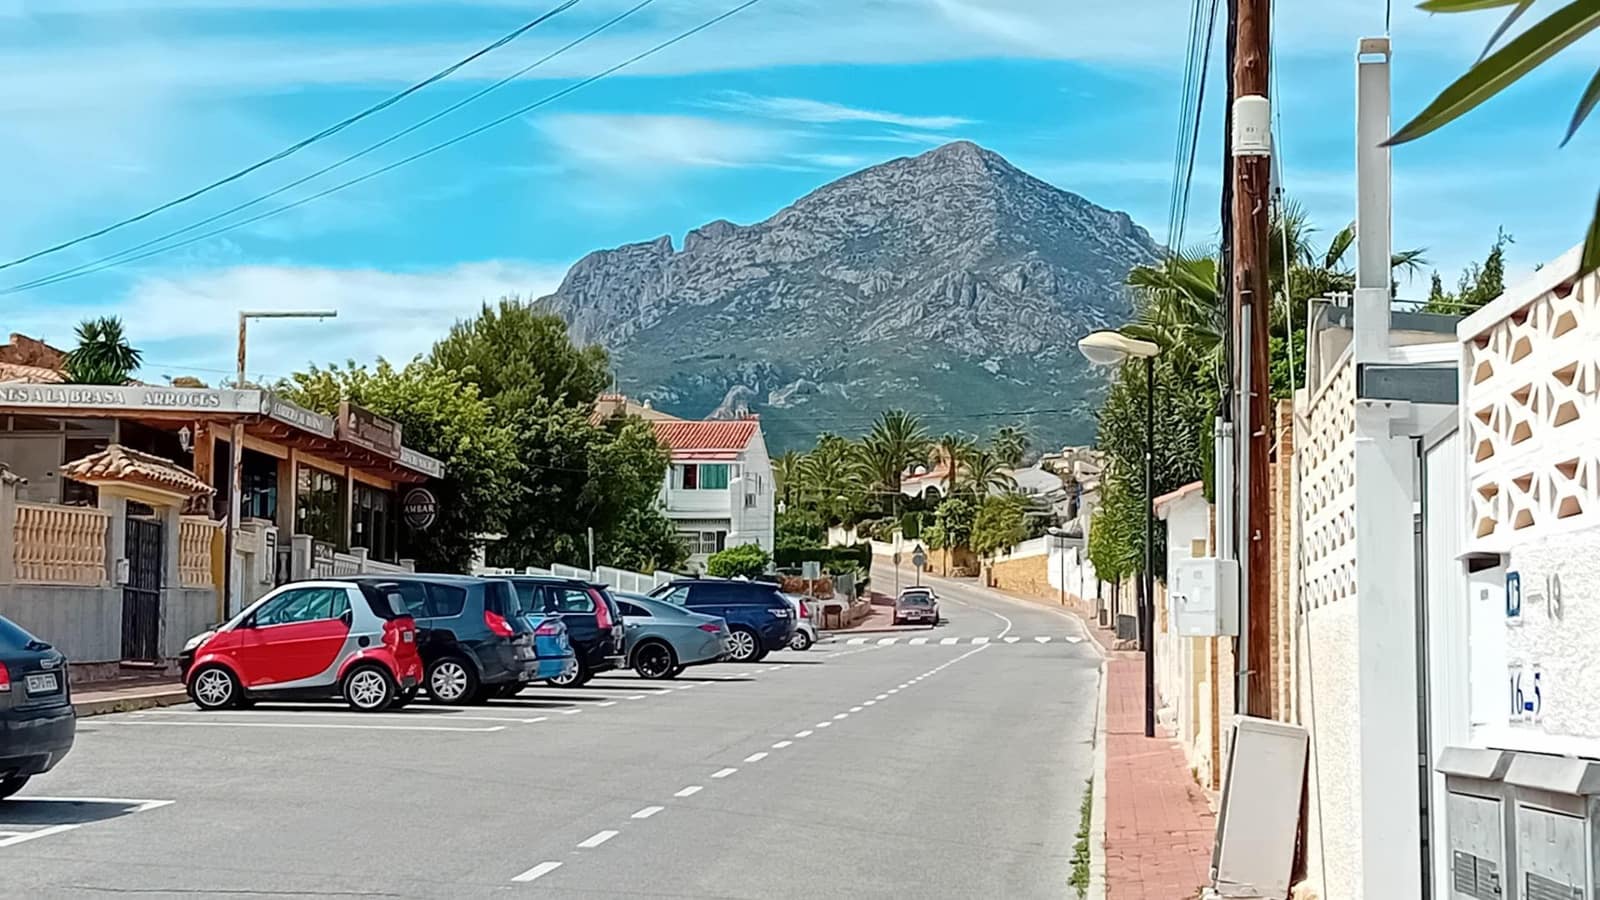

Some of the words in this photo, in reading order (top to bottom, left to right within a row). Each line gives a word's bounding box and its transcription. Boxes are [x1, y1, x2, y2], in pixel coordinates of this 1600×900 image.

[32, 389, 42, 402] A
[46, 390, 68, 403] LA
[69, 391, 125, 405] BRASA
[143, 392, 220, 408] ARROCES
[404, 504, 435, 513] AMBAR
